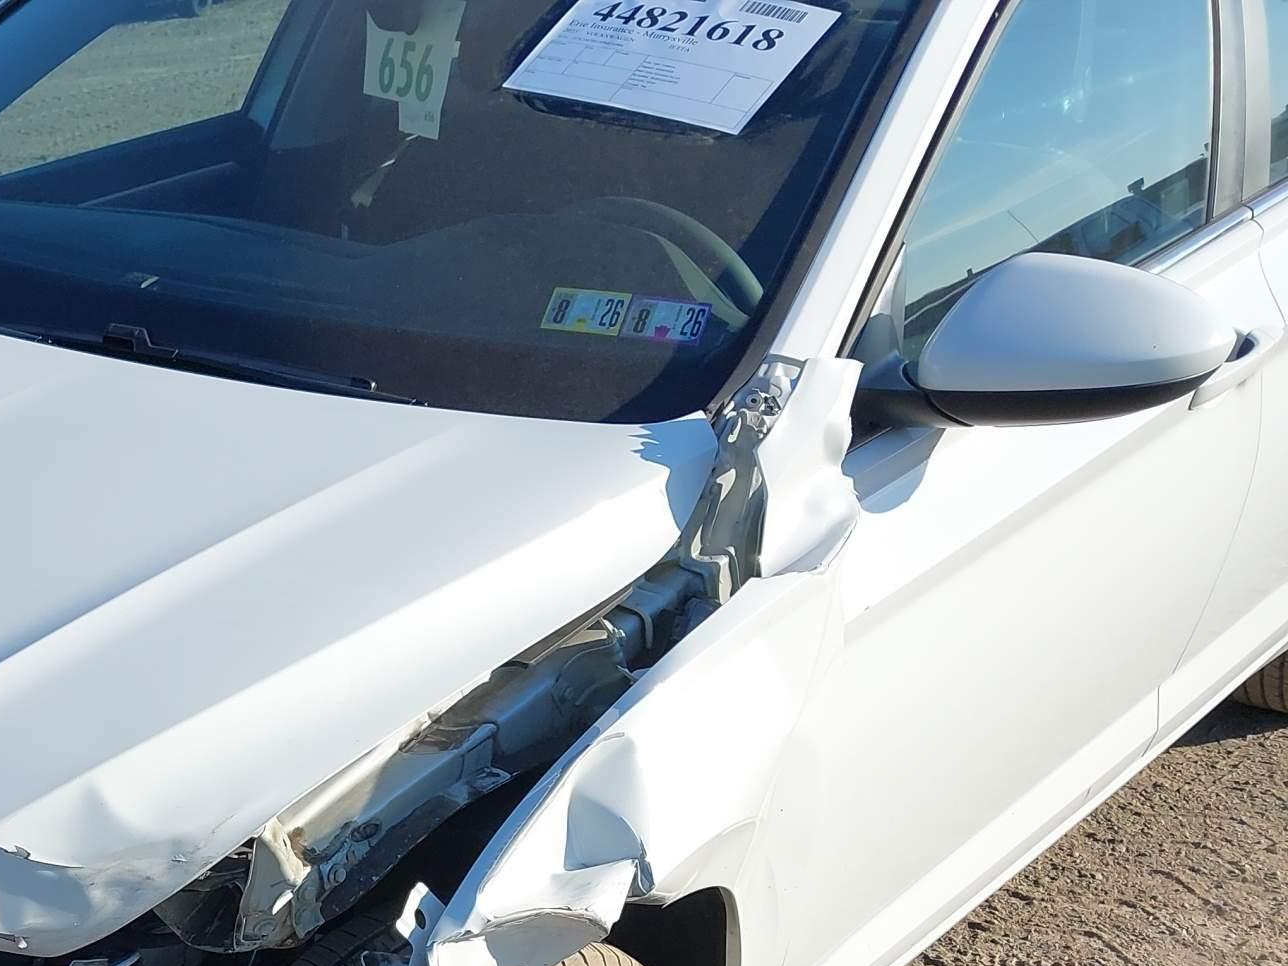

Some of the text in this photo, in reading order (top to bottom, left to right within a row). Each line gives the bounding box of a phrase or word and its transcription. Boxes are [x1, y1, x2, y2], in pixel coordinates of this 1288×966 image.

[569, 19, 589, 28] Erie
[591, 21, 635, 35] Insurance
[643, 30, 699, 46] Murrysville
[593, 2, 785, 51] 44821618
[379, 37, 434, 102] 656
[553, 298, 625, 328] 8 26
[632, 307, 706, 338] 8 26
